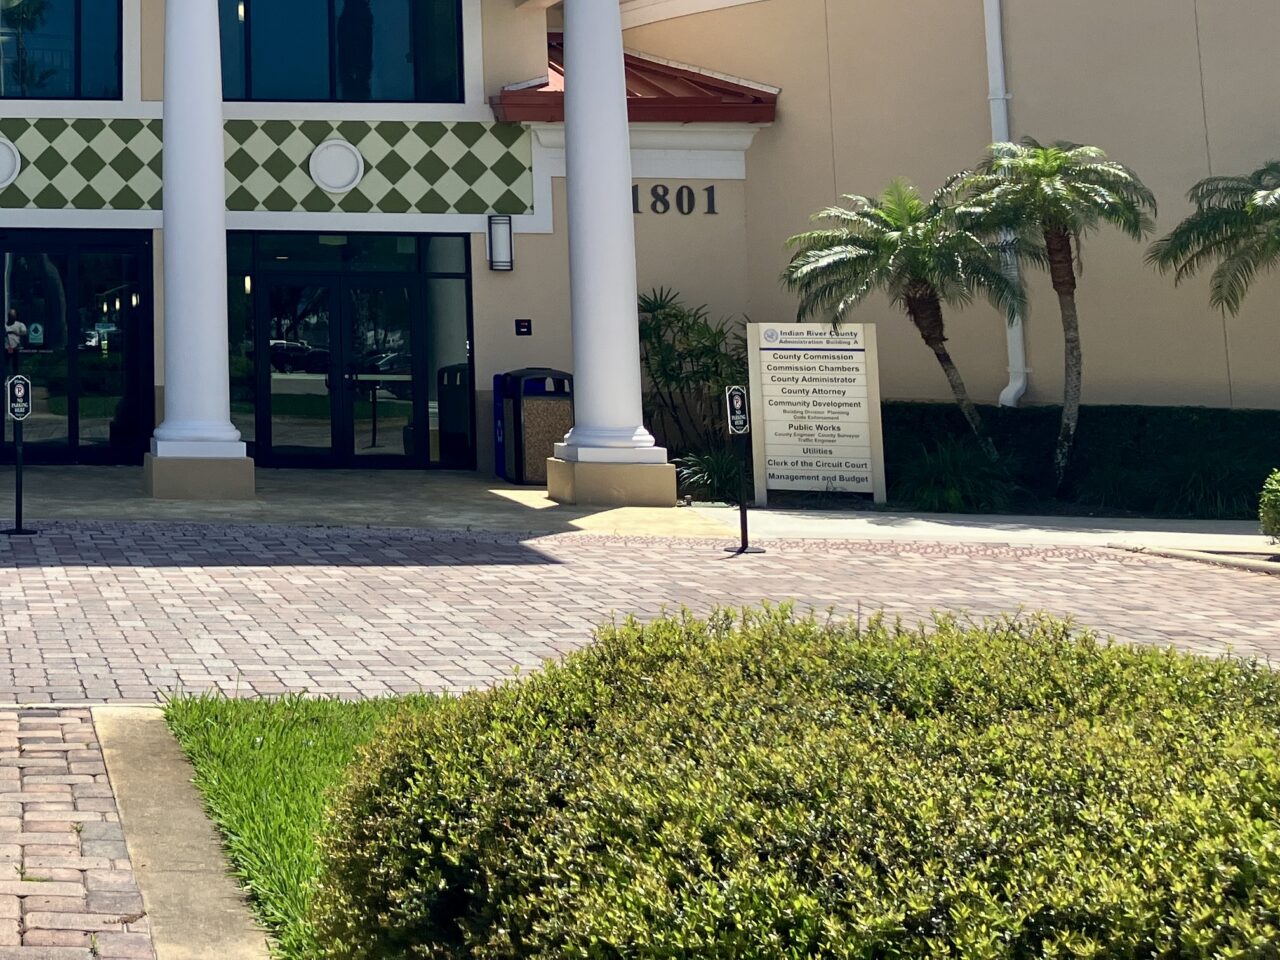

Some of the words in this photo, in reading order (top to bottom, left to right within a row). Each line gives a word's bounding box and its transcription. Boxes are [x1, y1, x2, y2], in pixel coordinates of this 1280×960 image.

[631, 183, 719, 215] 1801
[772, 352, 801, 361] County
[766, 364, 816, 372] Commission
[770, 375, 799, 383] County
[781, 387, 809, 396] County
[812, 388, 846, 396] Attorney
[768, 400, 810, 408] Community
[812, 400, 861, 408] Development
[768, 473, 819, 481] Management
[838, 475, 869, 483] Budget
